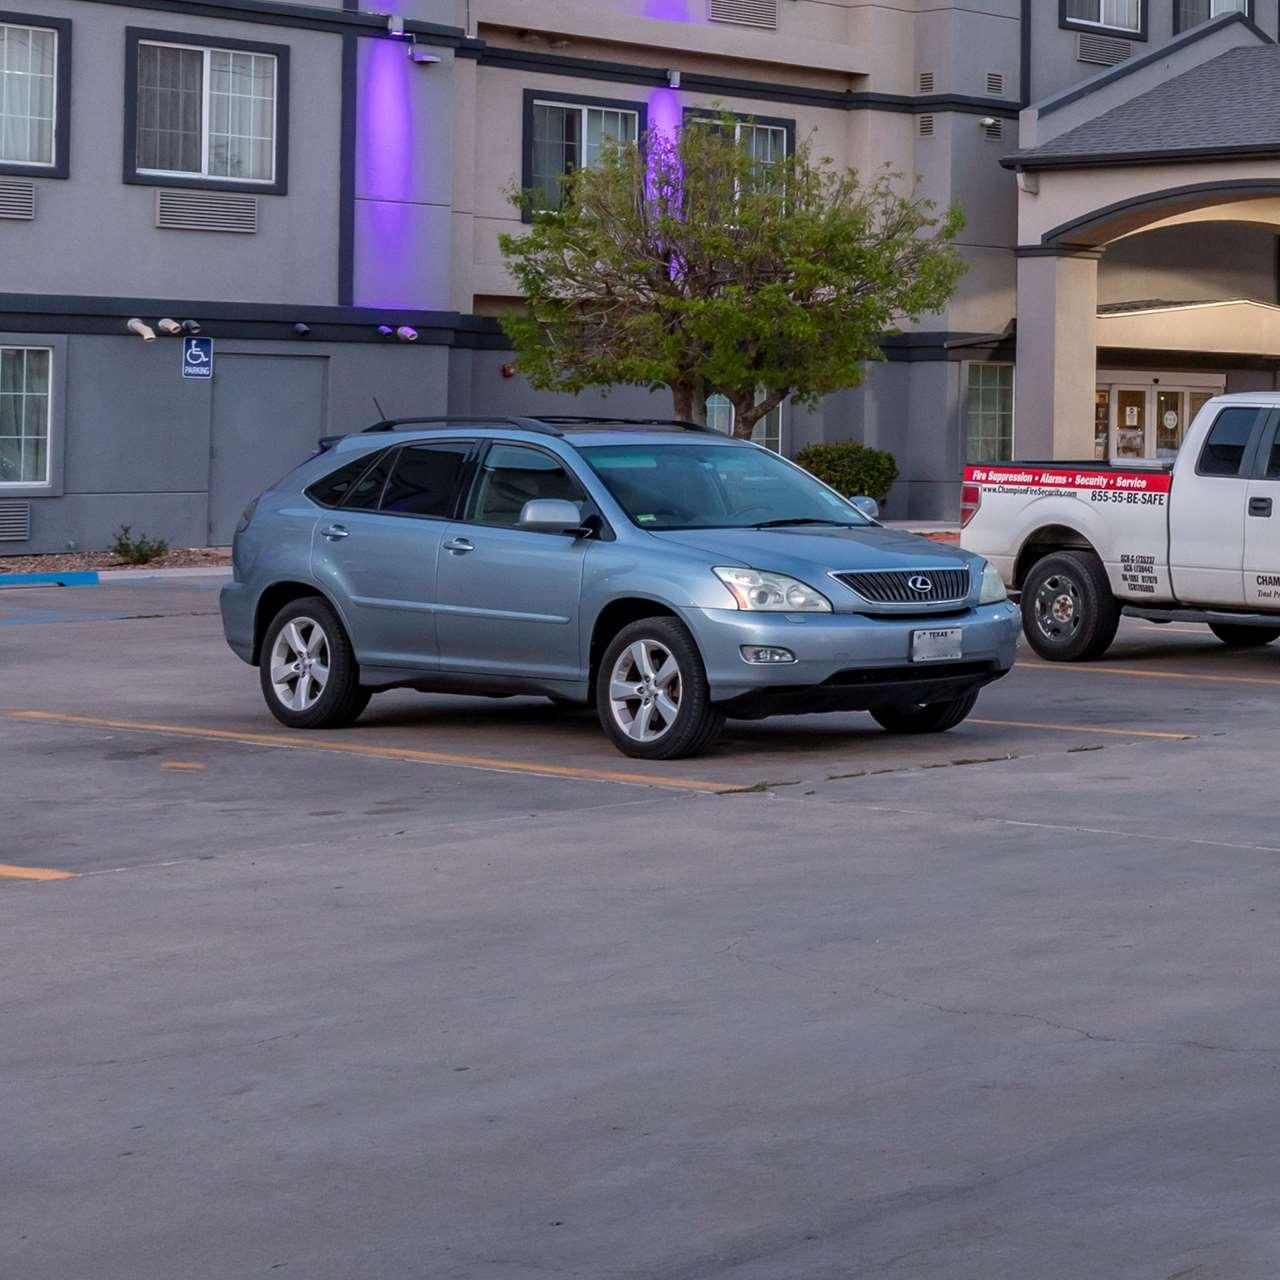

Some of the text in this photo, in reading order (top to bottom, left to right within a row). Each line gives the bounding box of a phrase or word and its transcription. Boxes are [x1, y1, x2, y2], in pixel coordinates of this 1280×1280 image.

[185, 366, 210, 375] PARKING
[973, 470, 1147, 488] Fire Suppression Alarms Security Service
[1091, 491, 1165, 505] 855-55-BE-SAFE
[1257, 590, 1272, 598] Total
